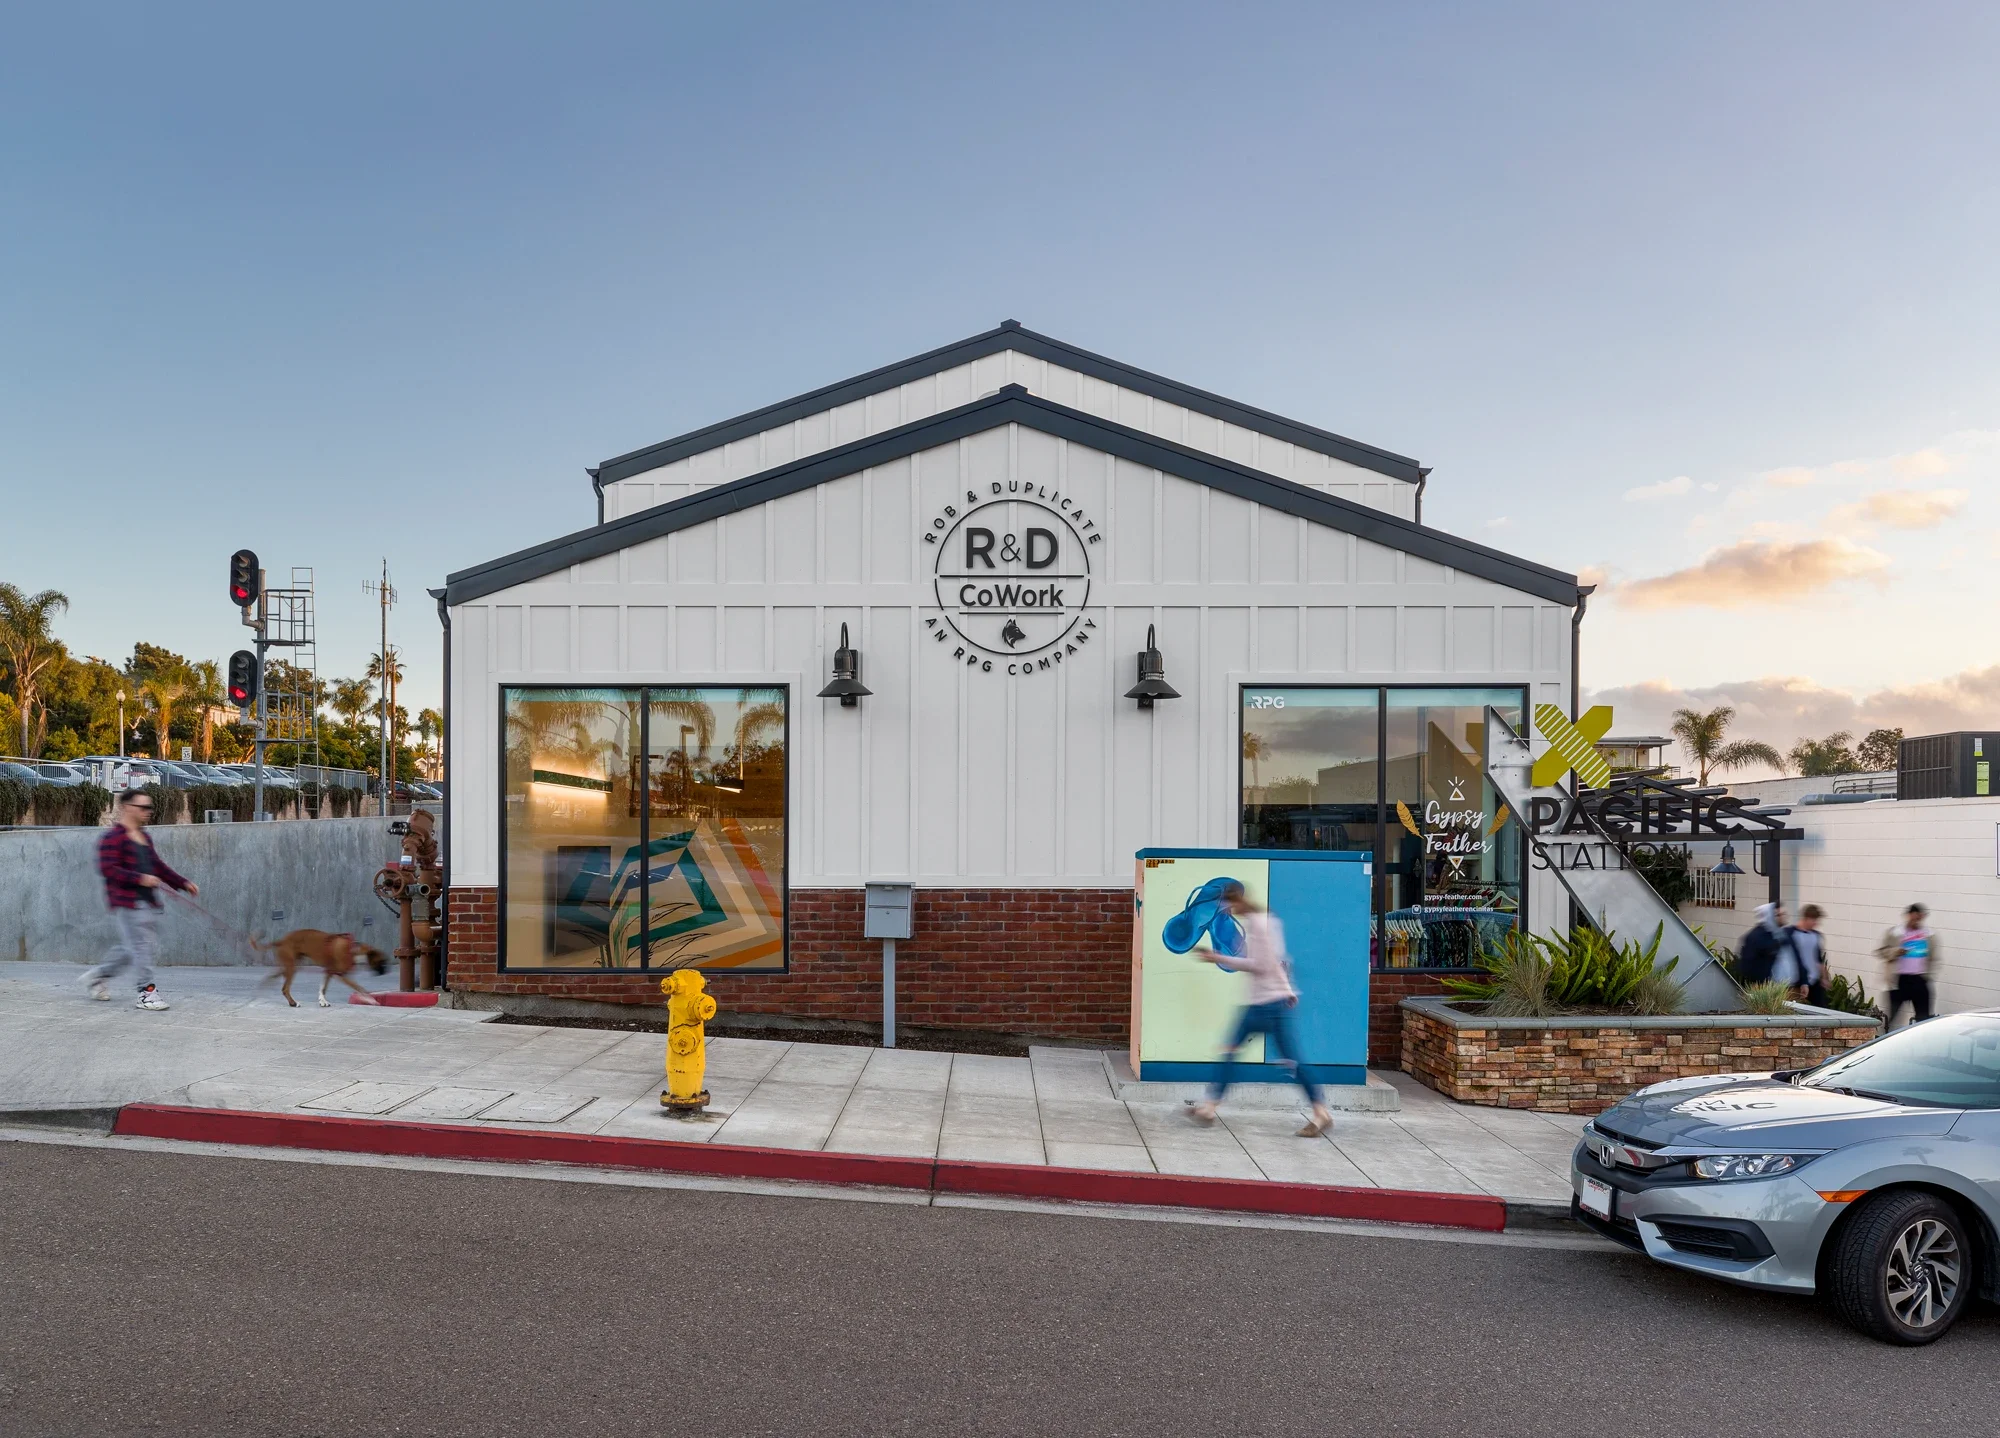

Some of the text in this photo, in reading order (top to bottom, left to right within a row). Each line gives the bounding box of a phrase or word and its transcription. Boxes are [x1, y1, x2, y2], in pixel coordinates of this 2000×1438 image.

[924, 480, 1101, 544] ROB & DUPLICATE
[966, 527, 1059, 569] R&D
[959, 584, 1064, 607] CoWork
[925, 617, 1097, 676] AN RPG COMPANY
[1250, 696, 1285, 709] RPG
[1425, 800, 1487, 829] Gypsy
[1531, 796, 1745, 835] PACIFIC
[1424, 832, 1493, 854] Feather
[1531, 841, 1688, 871] STATION
